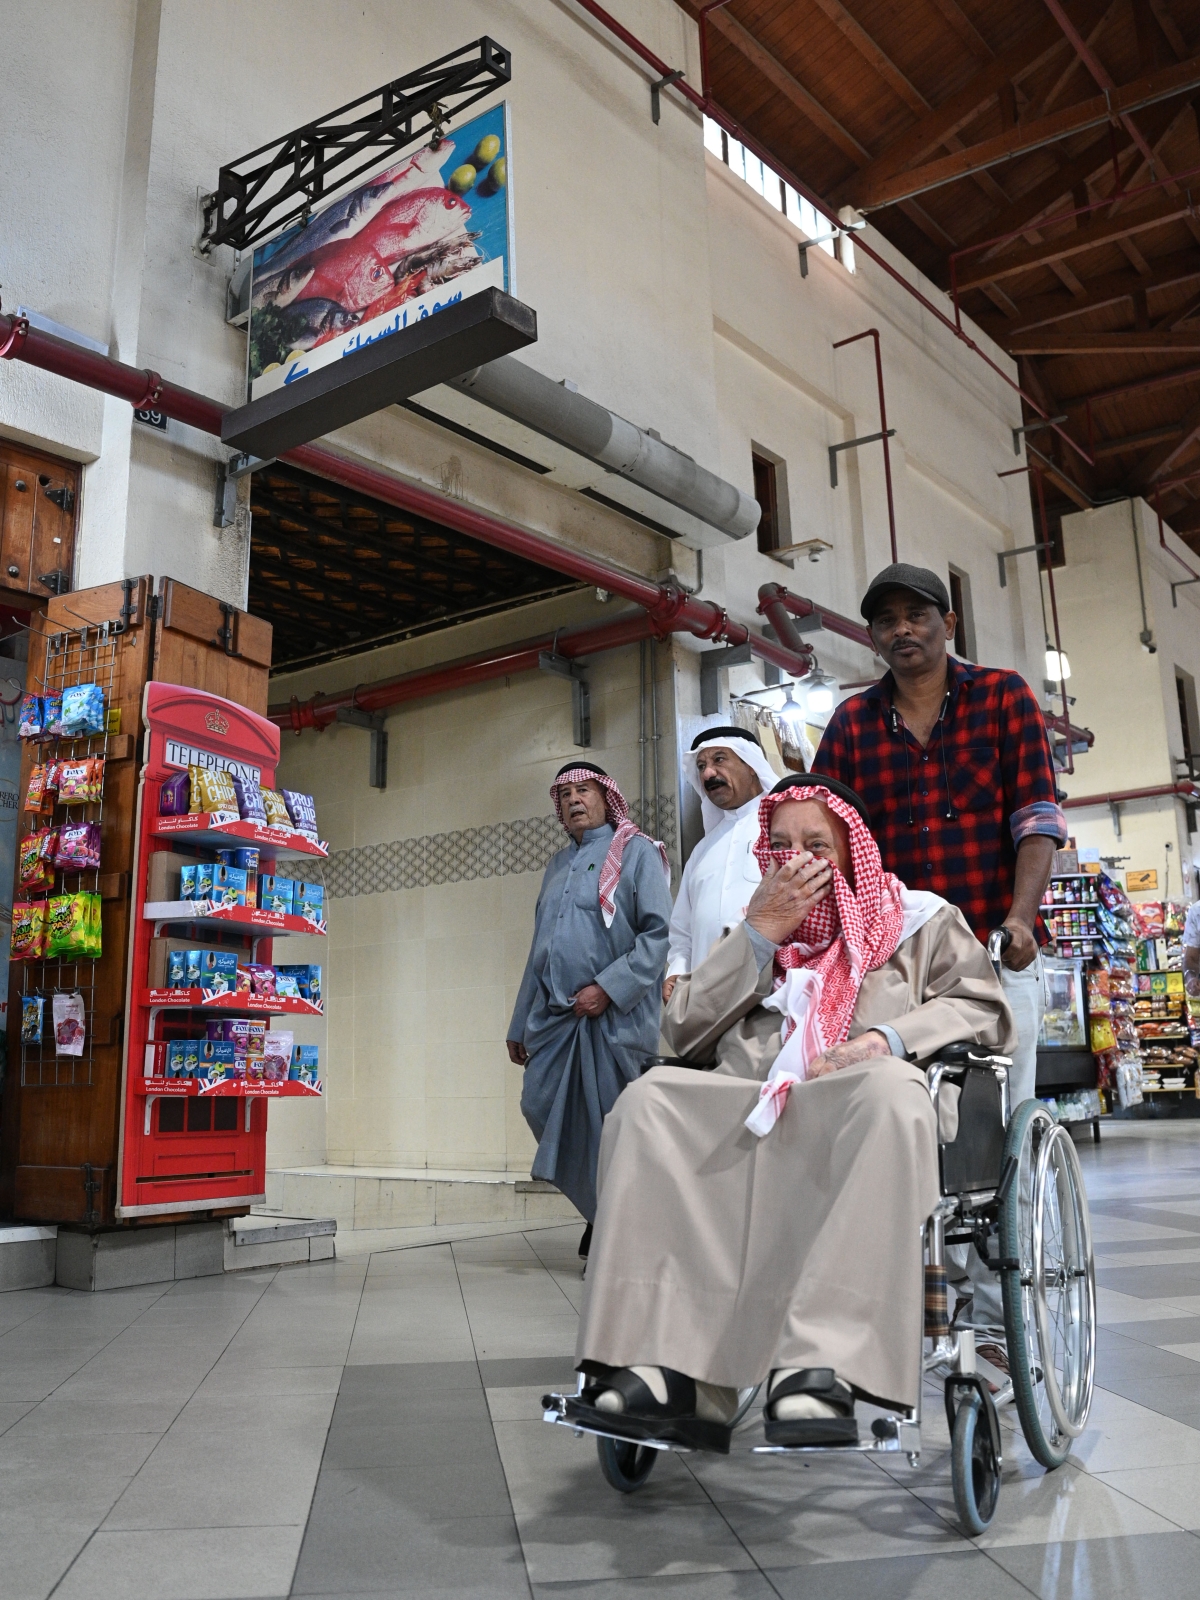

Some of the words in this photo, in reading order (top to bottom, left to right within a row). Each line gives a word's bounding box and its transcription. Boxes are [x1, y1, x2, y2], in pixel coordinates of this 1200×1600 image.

[343, 309, 407, 357] السمك
[168, 742, 259, 781] TELEPHONE
[203, 770, 228, 787] PRO
[268, 837, 287, 845] Chocolate
